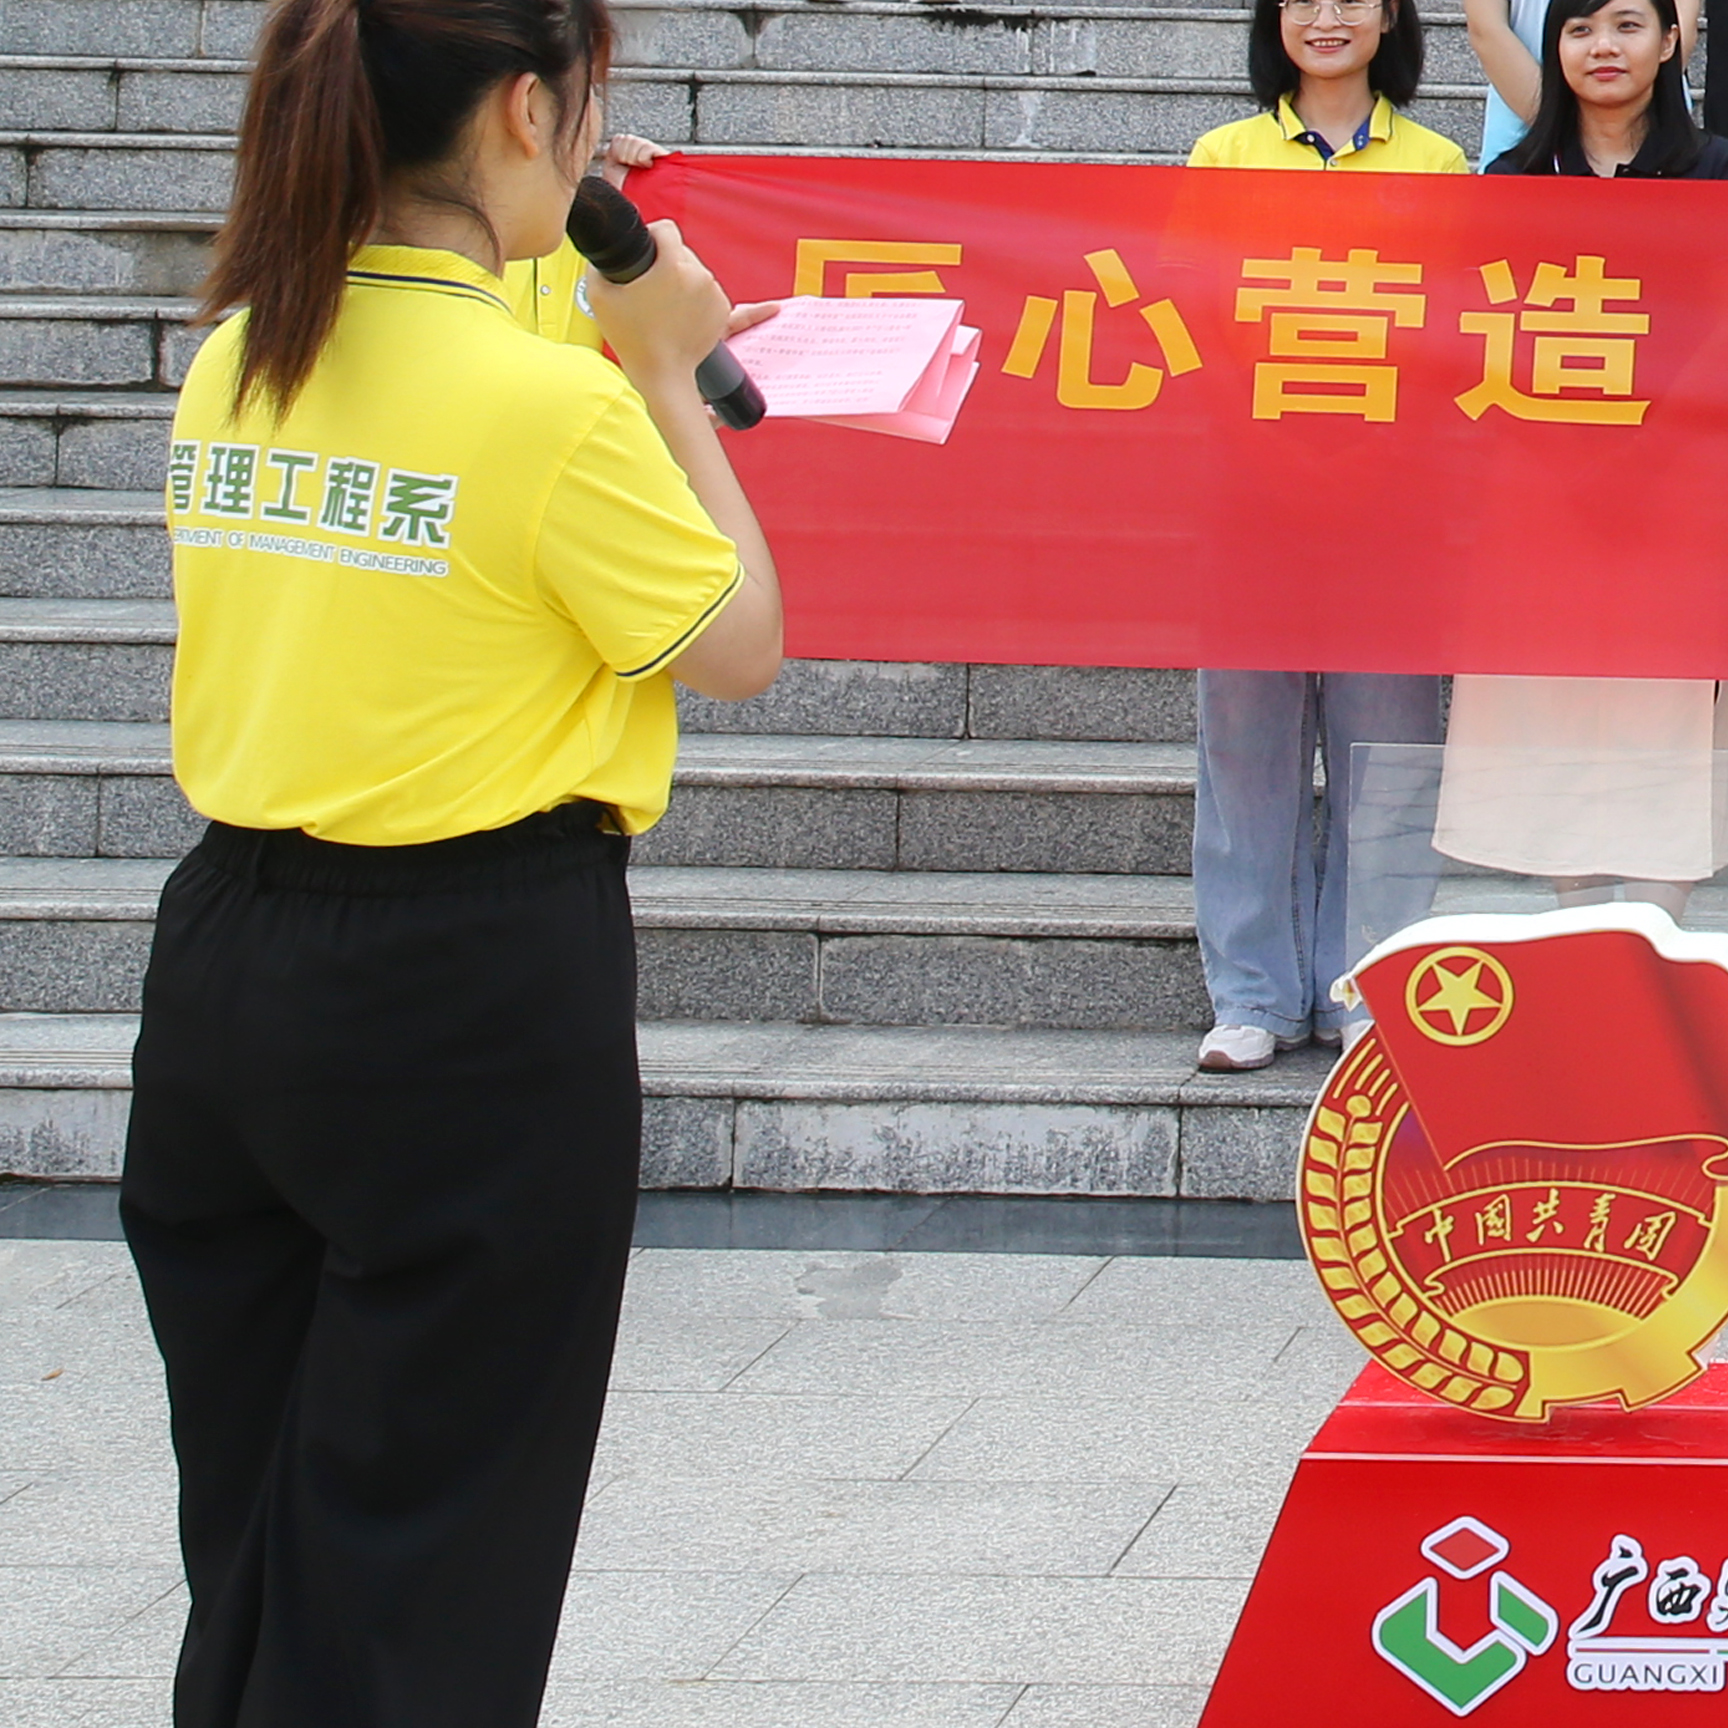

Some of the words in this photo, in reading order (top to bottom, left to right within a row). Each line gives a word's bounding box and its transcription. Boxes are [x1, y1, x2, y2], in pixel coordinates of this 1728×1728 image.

[248, 534, 336, 561] MANAGEMENT
[339, 549, 448, 576] ENGINEERING
[1574, 1662, 1719, 1688] GUANGXI
